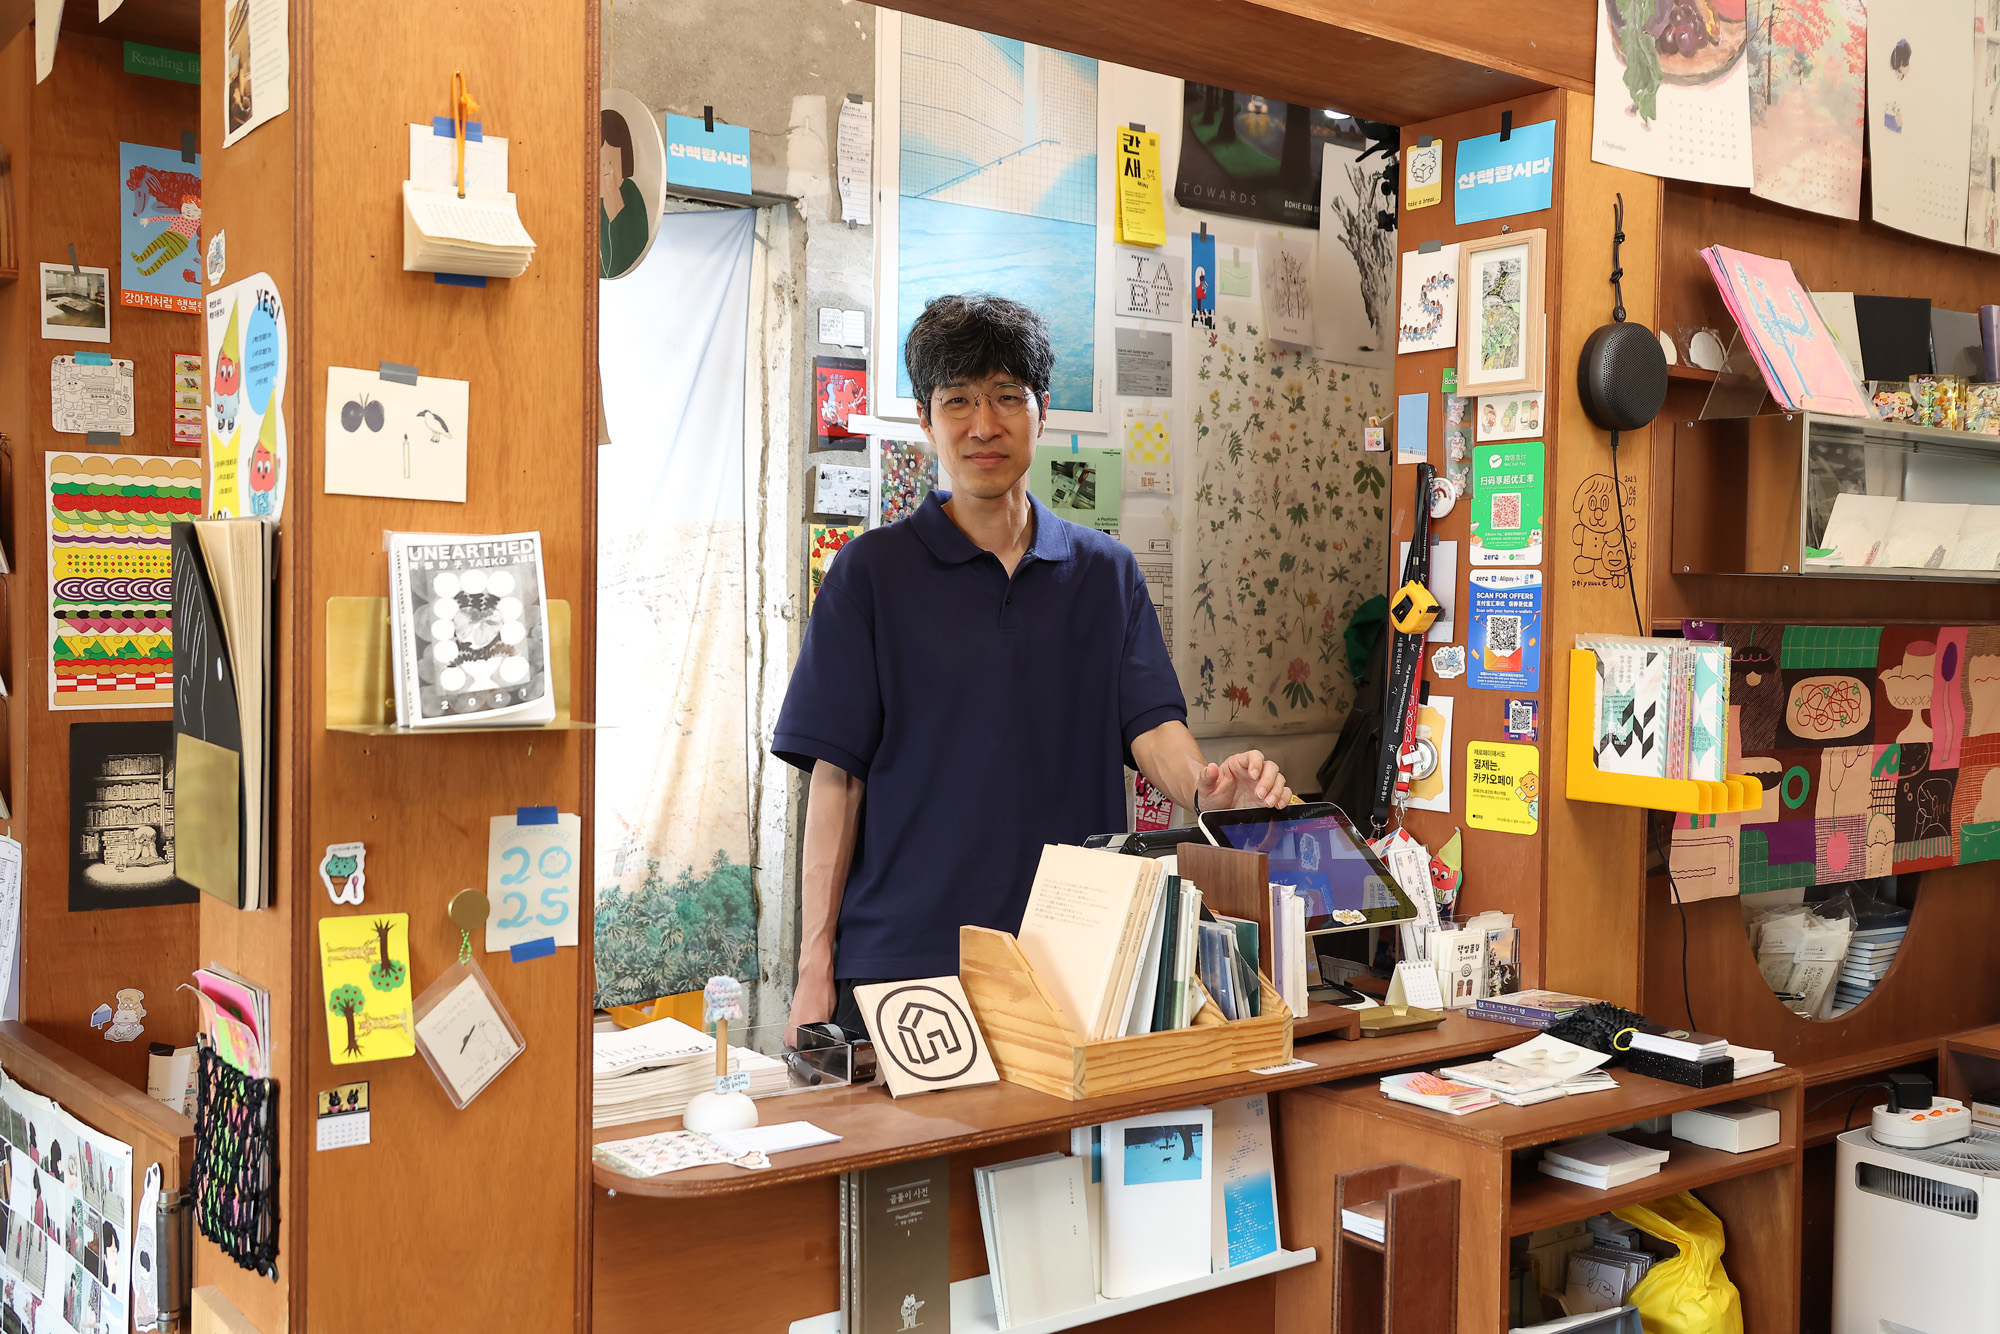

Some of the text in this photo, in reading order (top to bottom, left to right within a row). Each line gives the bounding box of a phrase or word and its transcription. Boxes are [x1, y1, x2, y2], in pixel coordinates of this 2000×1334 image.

[131, 50, 184, 74] Reading
[1123, 133, 1141, 155] 칸
[1124, 157, 1141, 178] 새
[1457, 157, 1551, 190] 산책합시다
[1182, 182, 1257, 206] TOWARDS
[1302, 203, 1313, 212] KIM
[124, 292, 173, 309] 강아지처럼
[256, 288, 280, 326] YES!
[1628, 497, 1636, 507] 07
[408, 540, 535, 561] UNEARTHED
[468, 557, 508, 568] TAEKO
[512, 554, 536, 564] ABE
[1396, 688, 1407, 719] International
[1393, 719, 1401, 734] Seoul
[1404, 709, 1414, 744] 2023
[1473, 759, 1501, 771] 결제는.
[1473, 773, 1514, 787] 카카오페이
[497, 886, 569, 929] 25
[1125, 912, 1134, 929] Handle
[1138, 911, 1147, 928] Handle
[1131, 941, 1139, 954] Care
[913, 1186, 929, 1199] 사전
